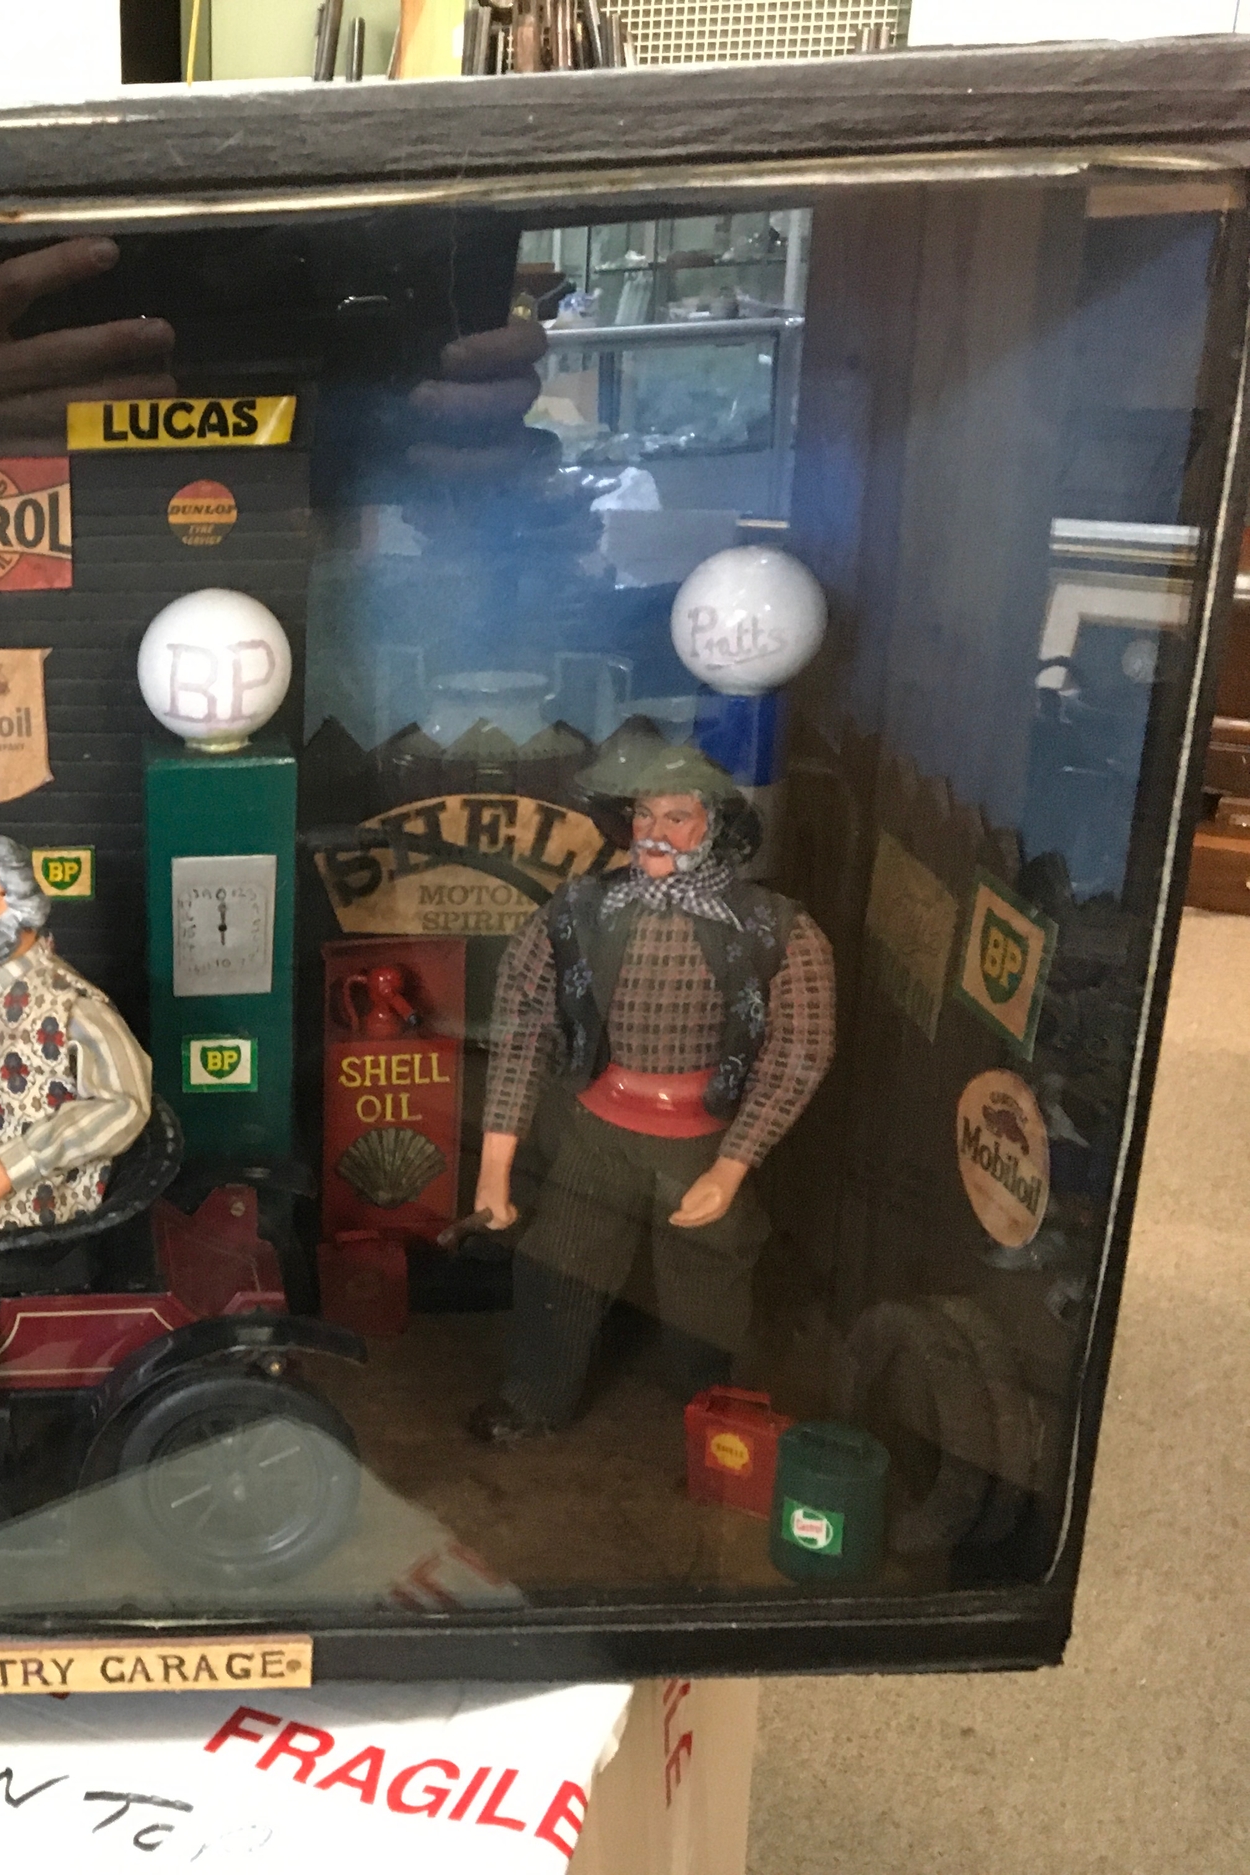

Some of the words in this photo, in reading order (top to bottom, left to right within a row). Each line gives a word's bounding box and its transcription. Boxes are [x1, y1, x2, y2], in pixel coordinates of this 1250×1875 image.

[102, 401, 259, 441] LUCAS
[170, 504, 237, 515] DUNLOP
[166, 638, 276, 723] BP
[48, 862, 79, 883] BP
[985, 926, 1022, 989] BP
[206, 1050, 238, 1071] BP
[338, 1053, 449, 1087] SHELL
[356, 1093, 422, 1122] OIL
[961, 1116, 1043, 1217] Mobiloil
[100, 1650, 287, 1683] GARAGE
[203, 1705, 589, 1860] FRAGILE
